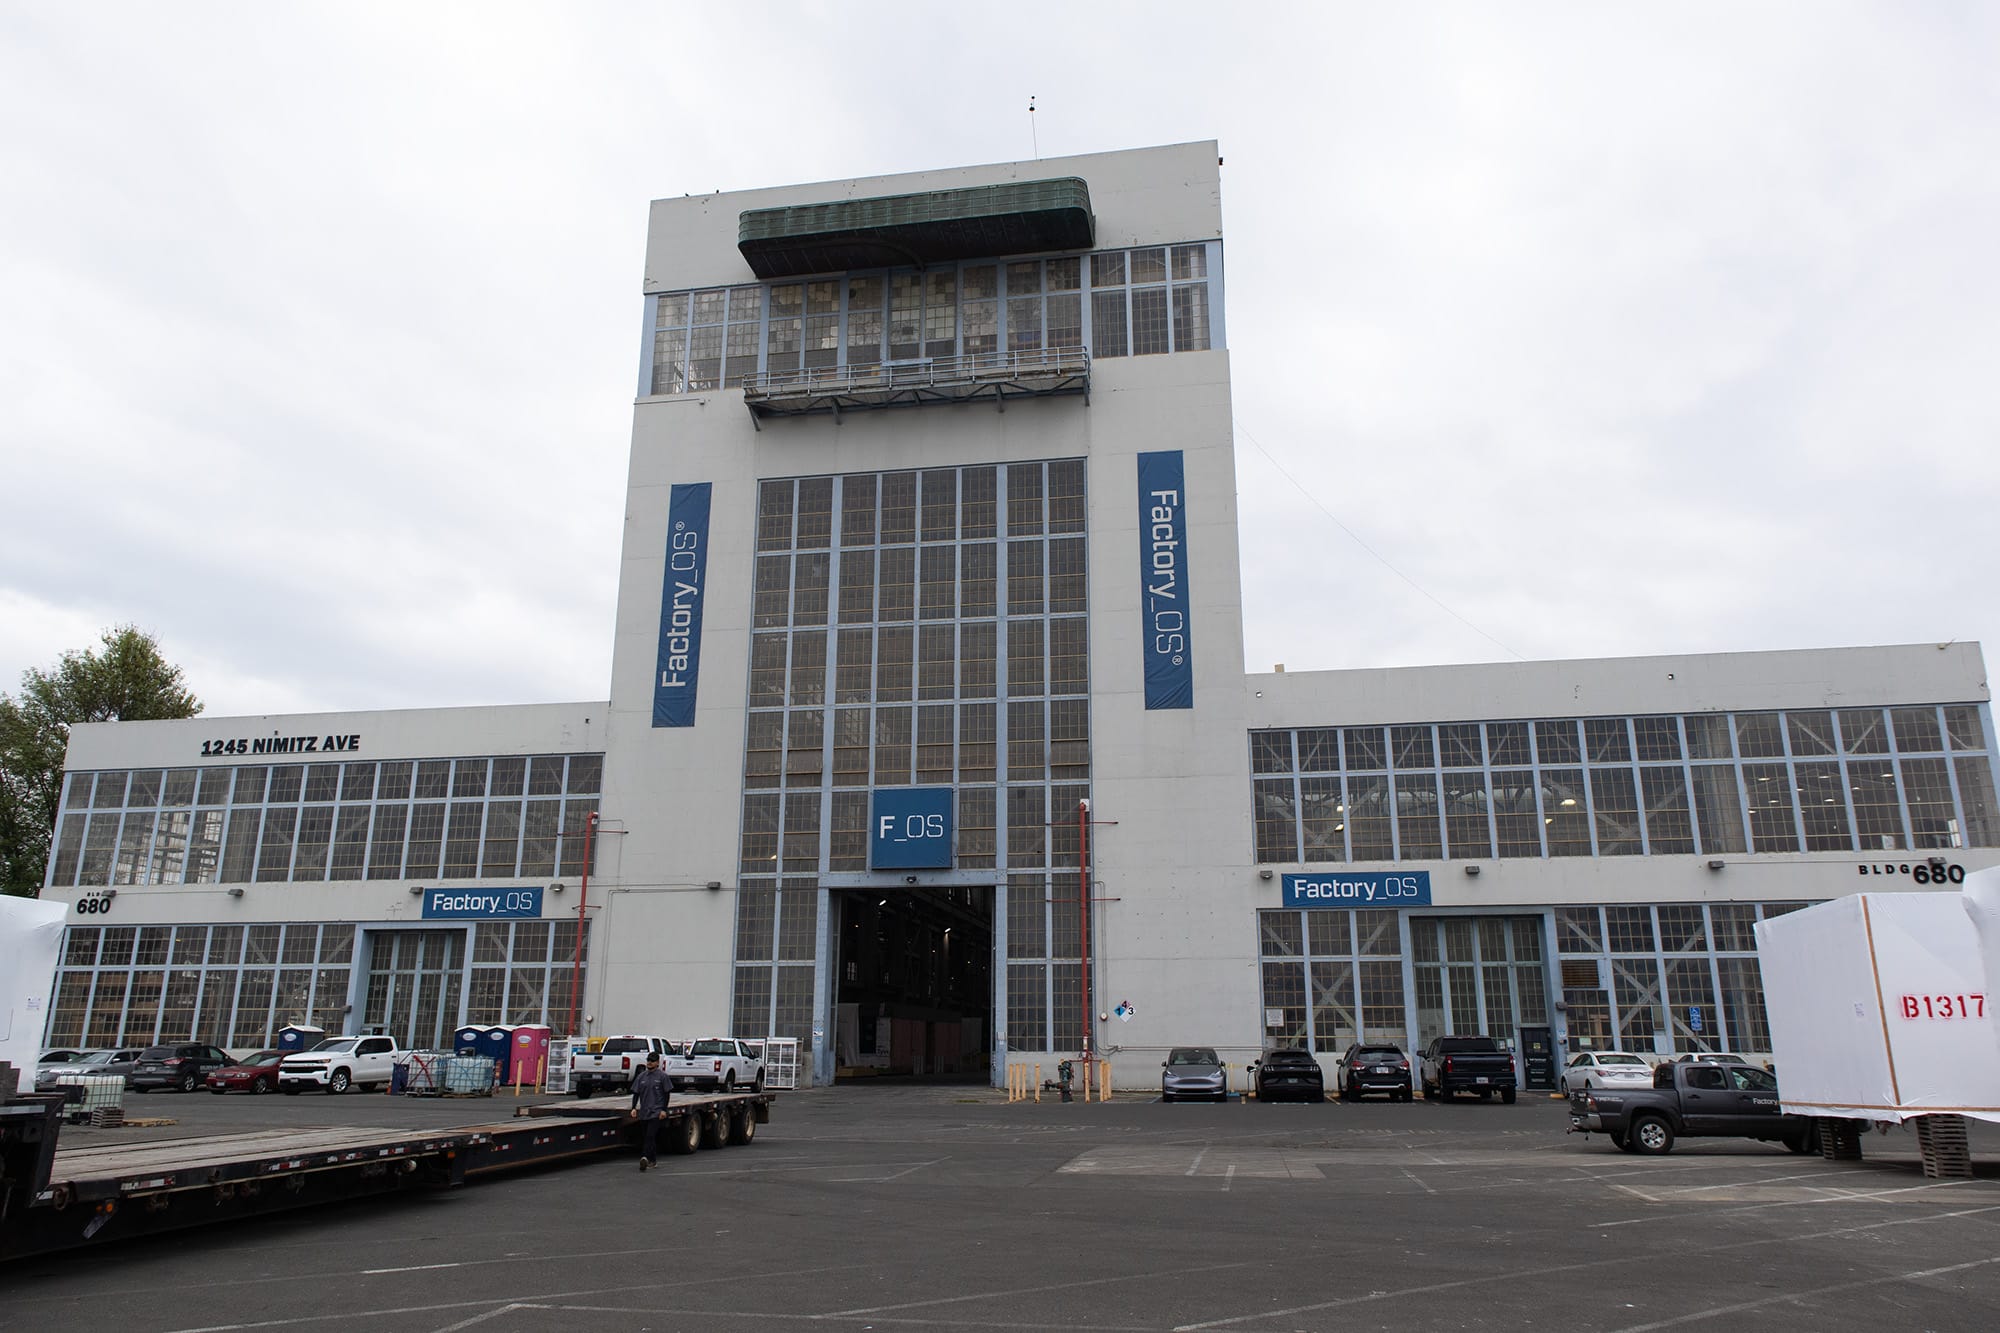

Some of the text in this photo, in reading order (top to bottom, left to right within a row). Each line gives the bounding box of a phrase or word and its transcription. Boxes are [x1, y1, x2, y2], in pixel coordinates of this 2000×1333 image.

[201, 735, 361, 755] 1245 NIMITZ AVE
[880, 814, 943, 842] F_OS
[1859, 864, 1966, 885] BLDG 680
[1294, 877, 1418, 901] Factory_OS
[76, 898, 111, 914] 680
[432, 892, 533, 913] Factory_OS
[1128, 1007, 1134, 1015] 3
[1902, 995, 1985, 1019] B1317
